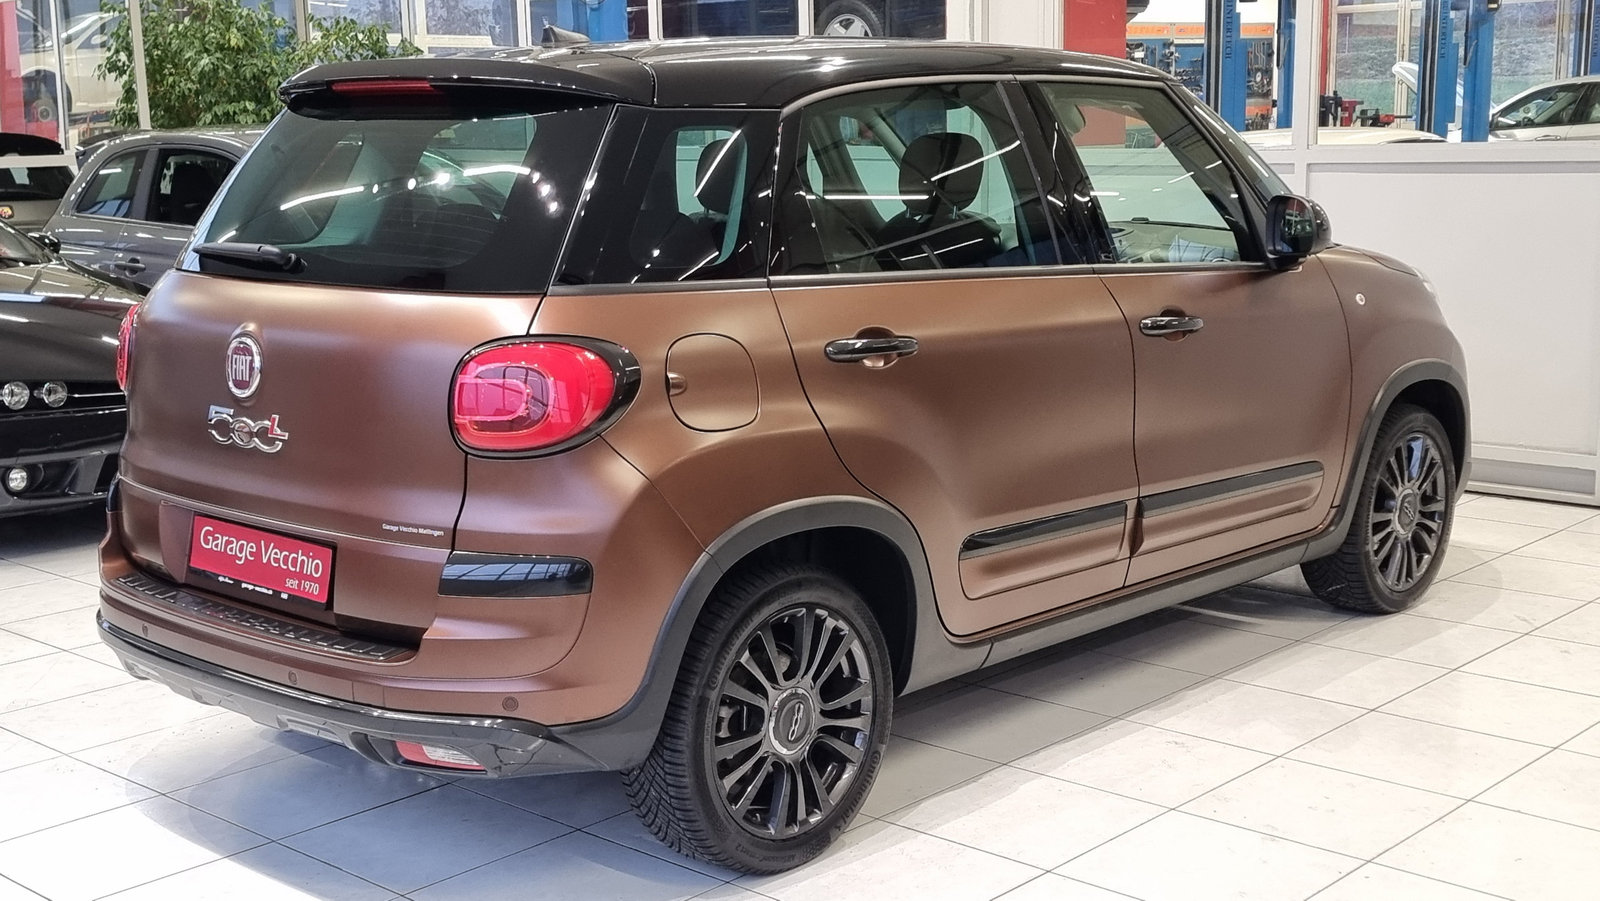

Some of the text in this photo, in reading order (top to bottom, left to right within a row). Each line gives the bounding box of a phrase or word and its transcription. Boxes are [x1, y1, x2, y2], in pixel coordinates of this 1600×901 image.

[232, 354, 252, 381] FIAT
[382, 523, 399, 532] Garage
[399, 525, 418, 534] Vecchio
[200, 526, 323, 578] Garage Vecchio
[284, 577, 299, 590] seit
[301, 580, 320, 596] 1970
